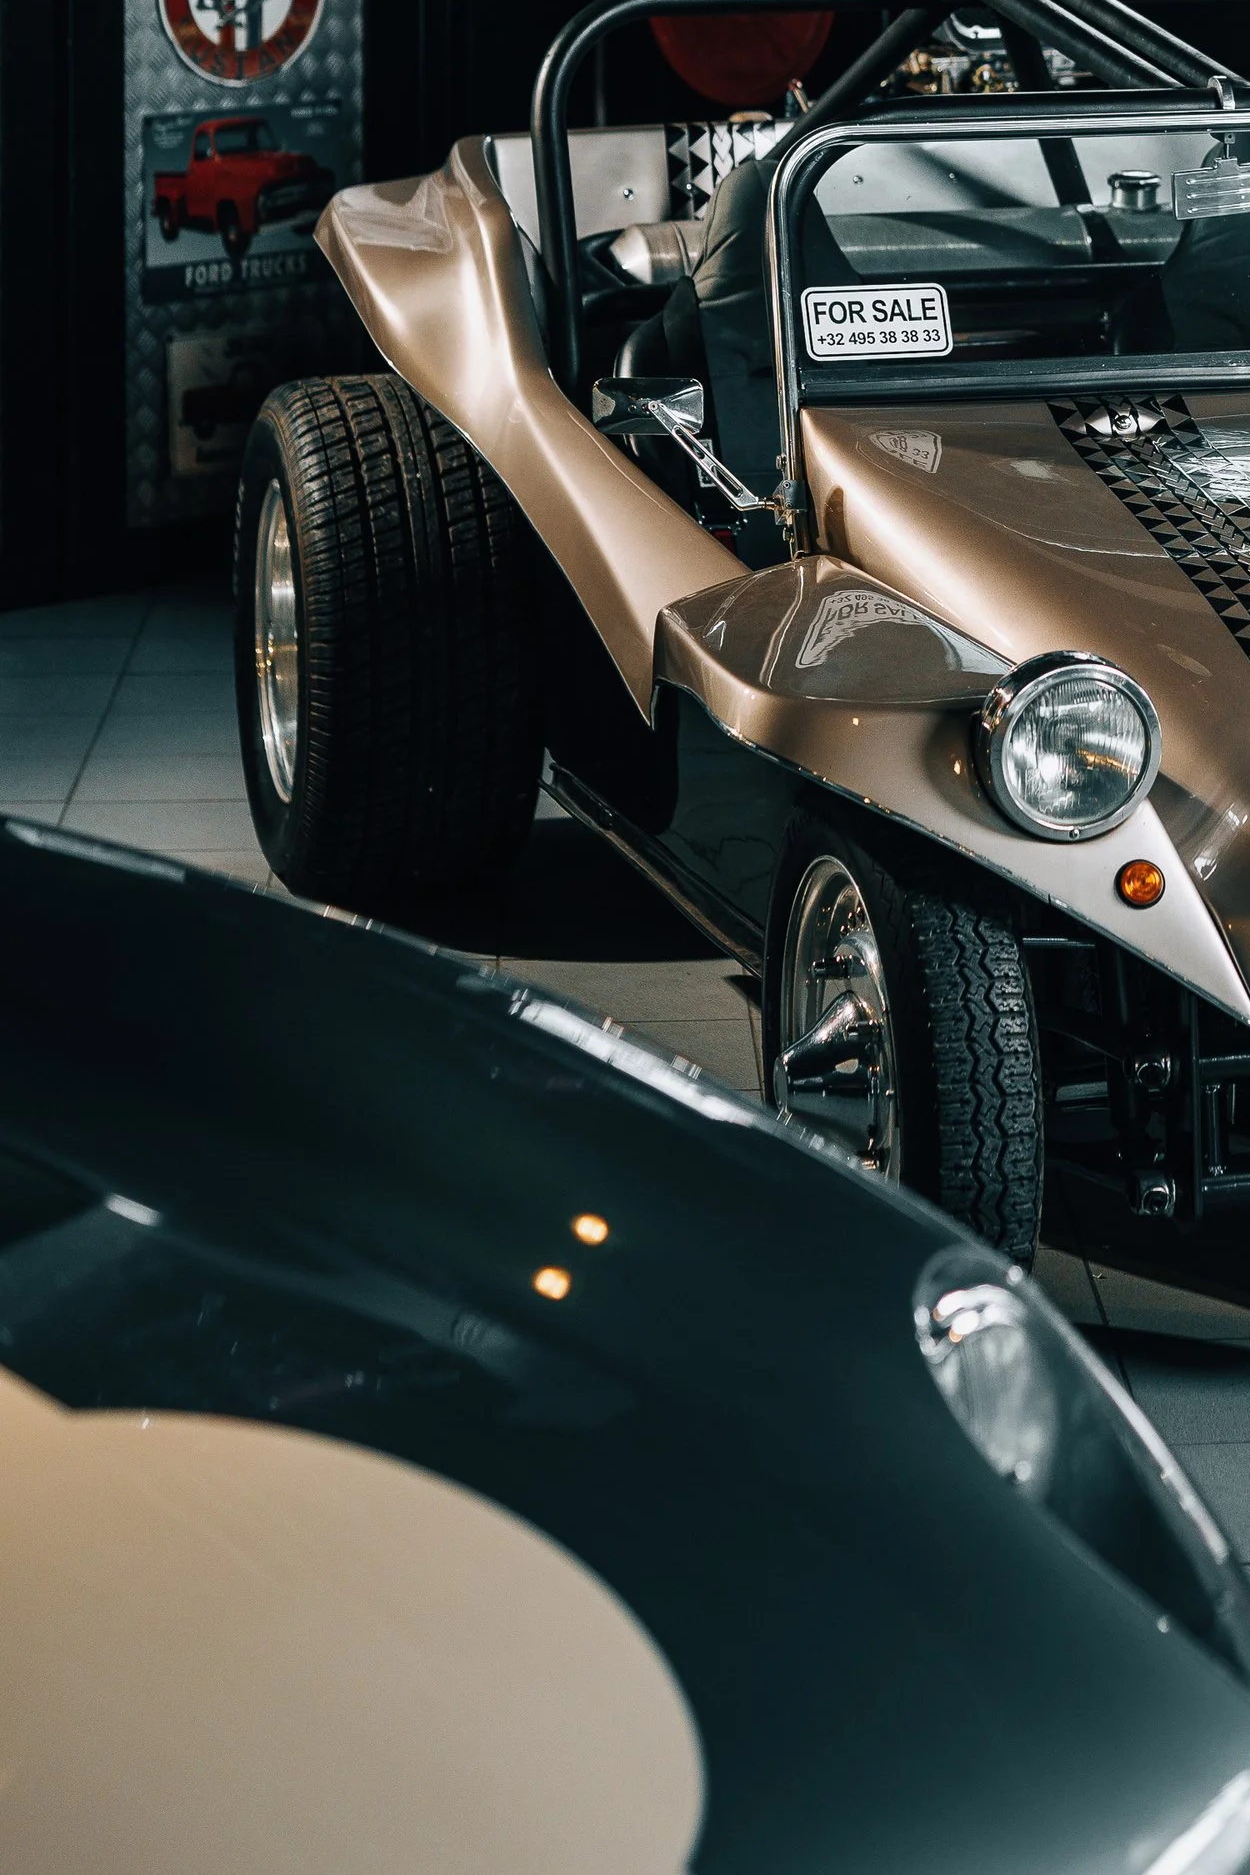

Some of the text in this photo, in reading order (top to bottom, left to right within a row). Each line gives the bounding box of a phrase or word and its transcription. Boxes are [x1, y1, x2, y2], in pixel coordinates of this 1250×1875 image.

[184, 262, 232, 289] FORD
[241, 254, 307, 278] TRUCKS
[813, 298, 938, 325] FOR SALE
[817, 328, 941, 346] +32 495 38 38 33
